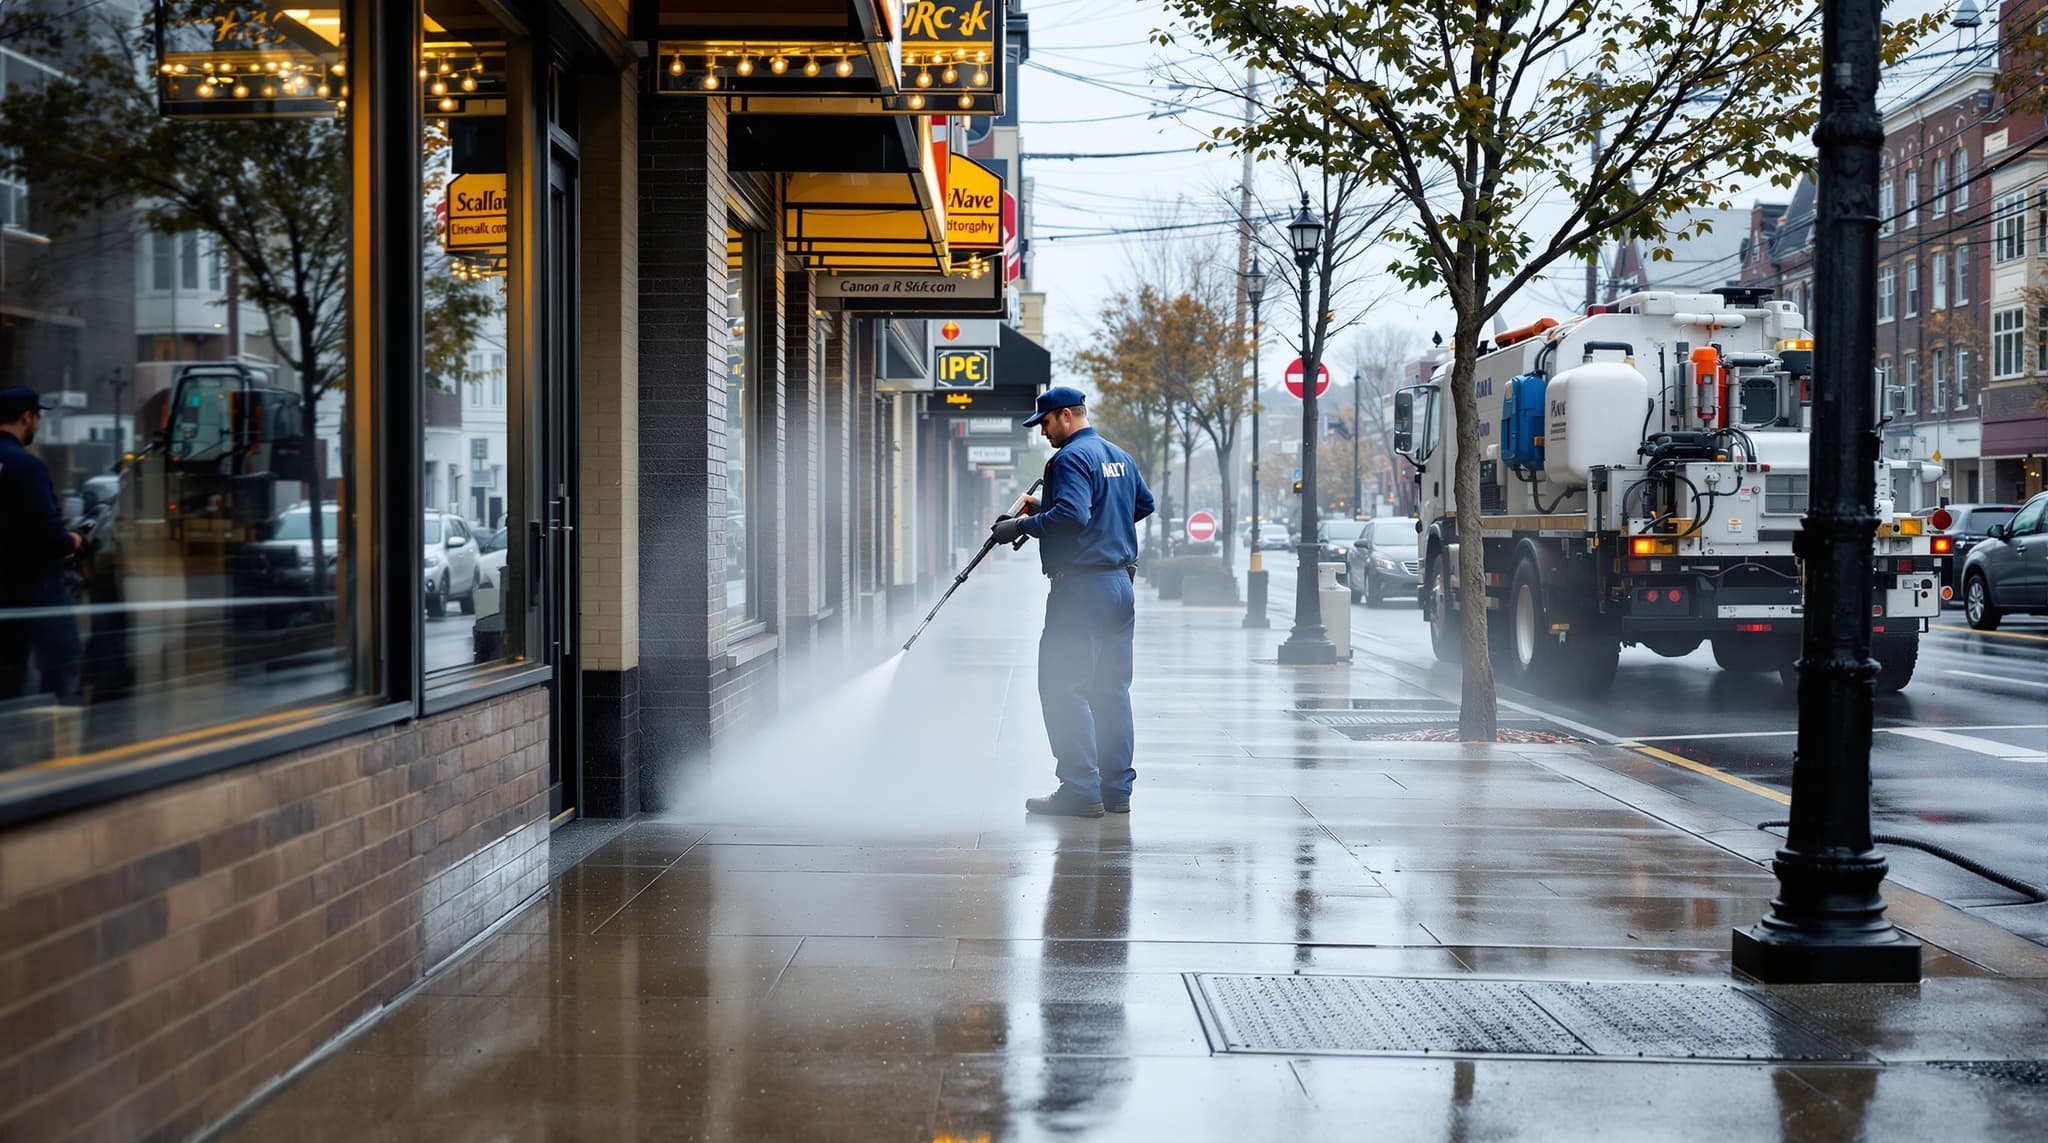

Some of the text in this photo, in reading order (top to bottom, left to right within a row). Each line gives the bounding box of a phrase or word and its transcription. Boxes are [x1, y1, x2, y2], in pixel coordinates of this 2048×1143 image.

[948, 188, 994, 208] Nave
[840, 280, 879, 293] Canon
[940, 356, 981, 380] IPE
